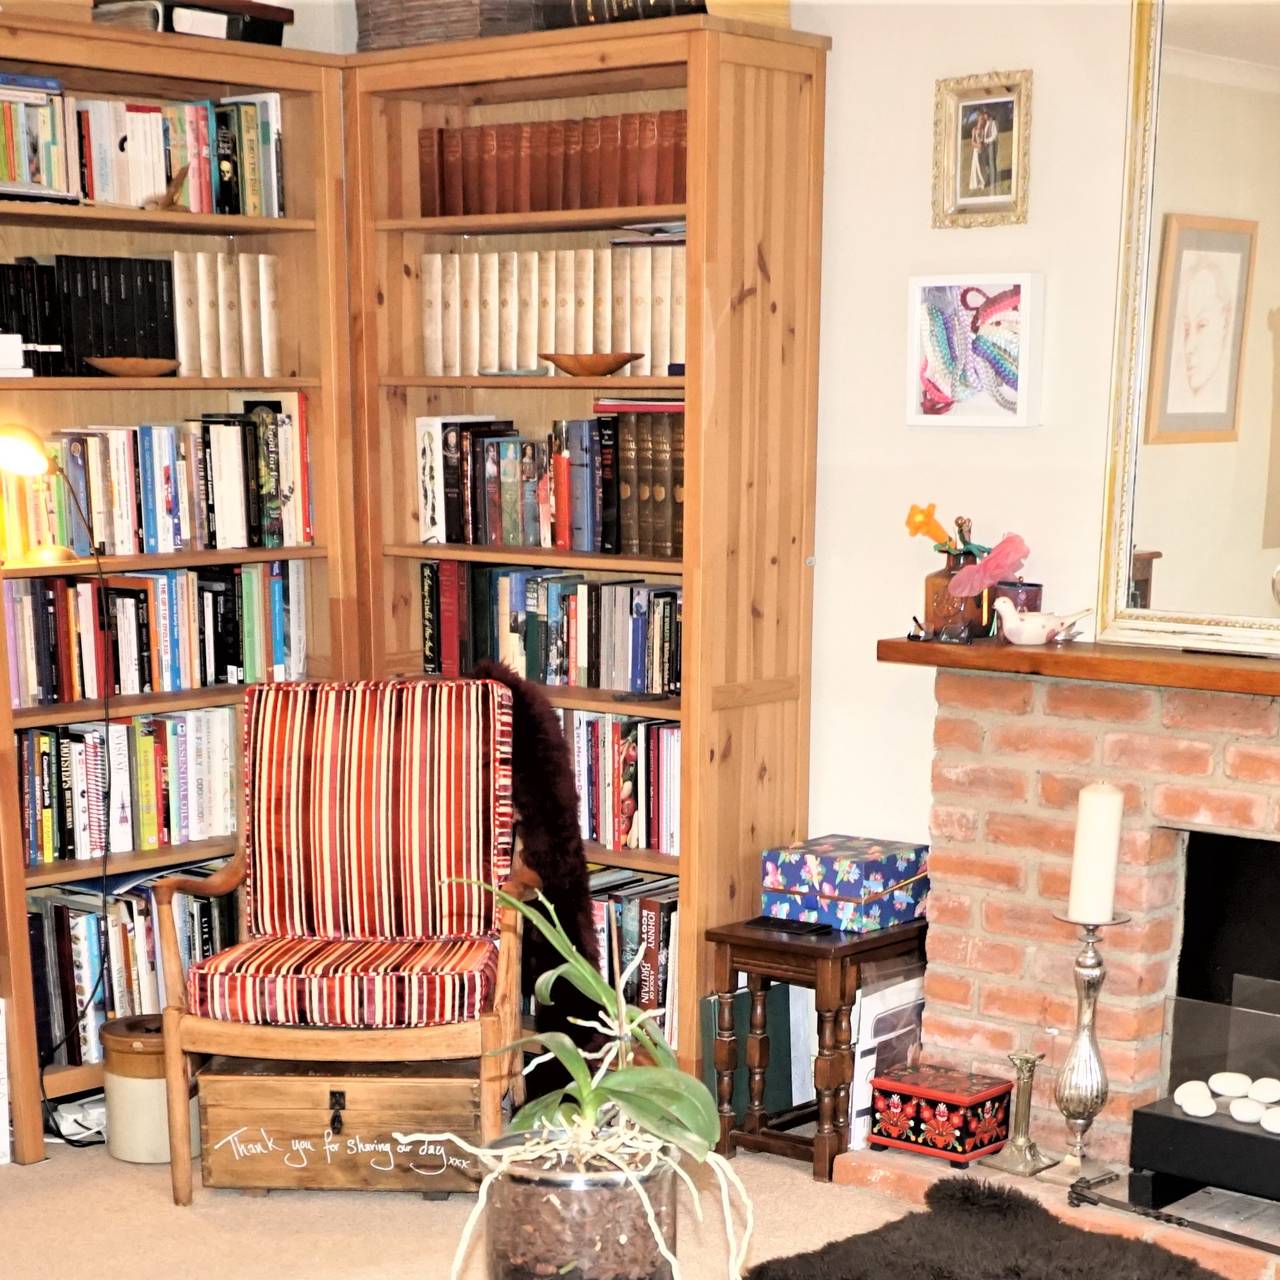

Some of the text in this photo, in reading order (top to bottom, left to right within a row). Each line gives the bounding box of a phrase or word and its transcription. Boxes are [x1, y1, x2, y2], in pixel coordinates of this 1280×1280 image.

[268, 425, 276, 451] Food
[60, 740, 72, 788] FOOTSTEPS
[178, 736, 187, 797] ESSENTIAL
[641, 961, 651, 1003] BRITAIN
[214, 1127, 282, 1160] Thank
[284, 1140, 315, 1167] you
[323, 1130, 340, 1163] for
[409, 1139, 447, 1175] day
